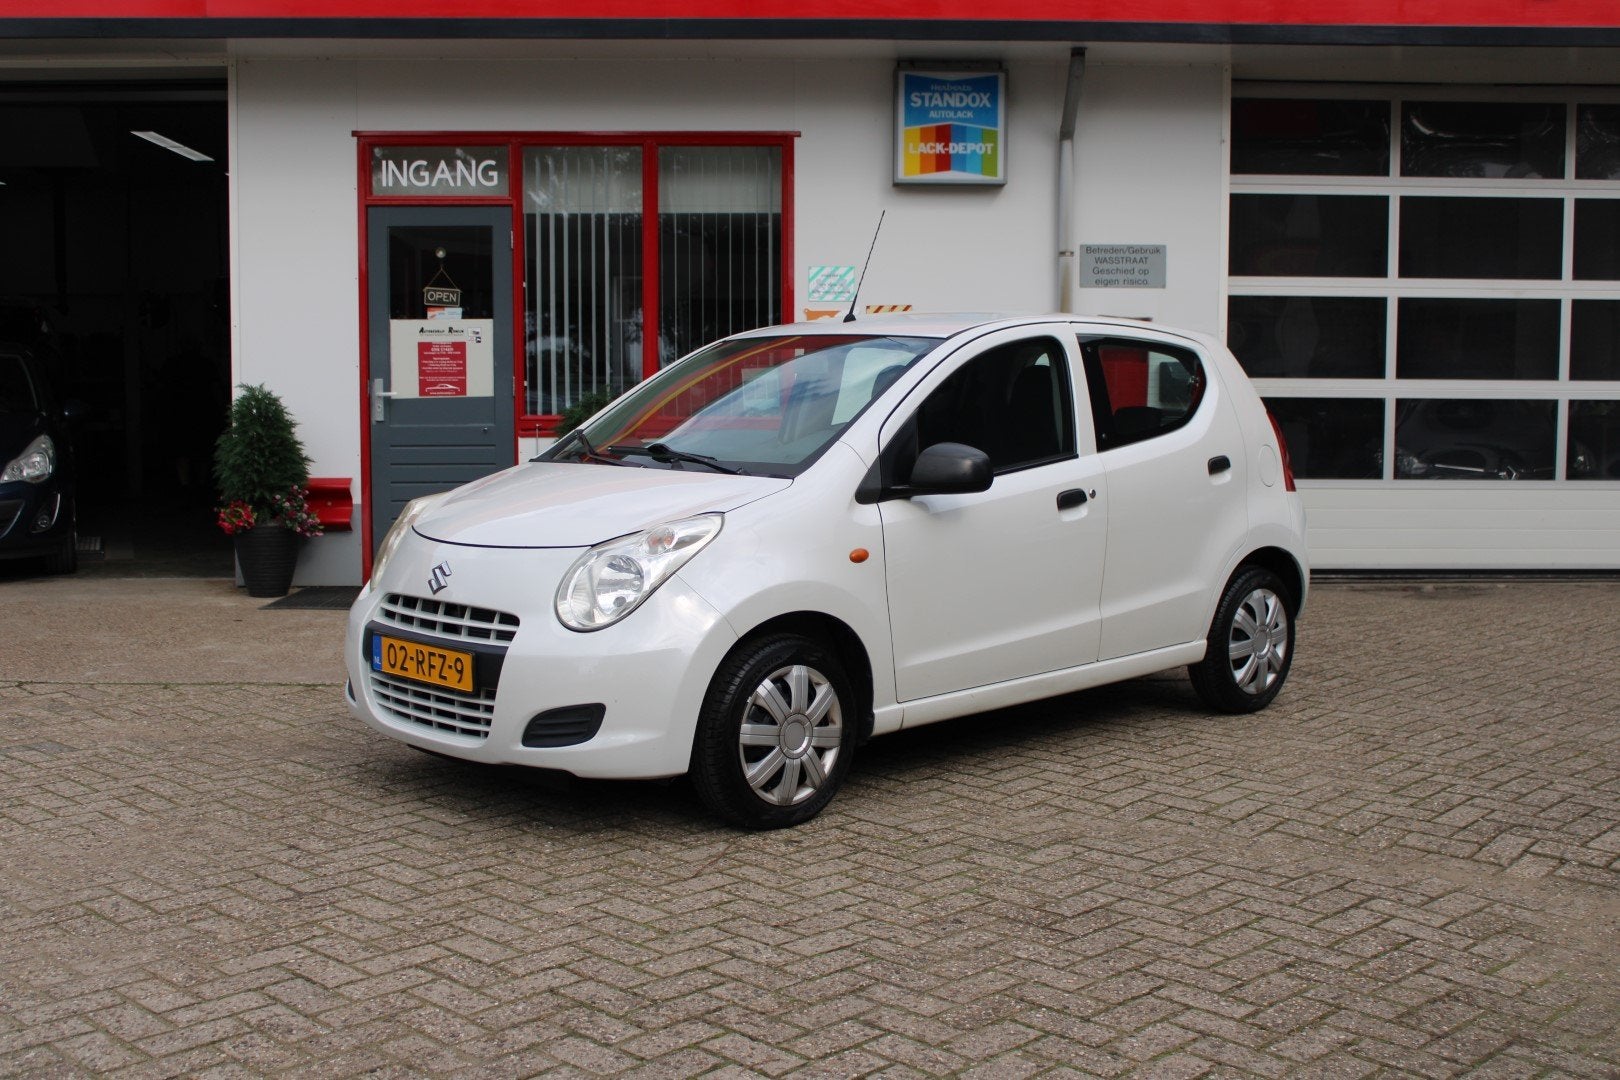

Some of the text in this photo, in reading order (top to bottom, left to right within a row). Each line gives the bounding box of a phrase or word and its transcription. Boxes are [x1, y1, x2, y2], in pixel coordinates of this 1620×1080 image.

[910, 92, 991, 108] STANDOX
[929, 110, 974, 119] AUTOLACK
[909, 142, 994, 155] LACK-DEPOT
[381, 160, 498, 187] INGANG
[1086, 246, 1161, 255] Betreden/Gebruik
[1095, 257, 1149, 265] WASSTRAAT
[1092, 266, 1149, 276] Geschied op
[1094, 278, 1119, 287] eigen
[427, 291, 457, 303] OPEN
[387, 643, 464, 684] 02-RFZ-9
